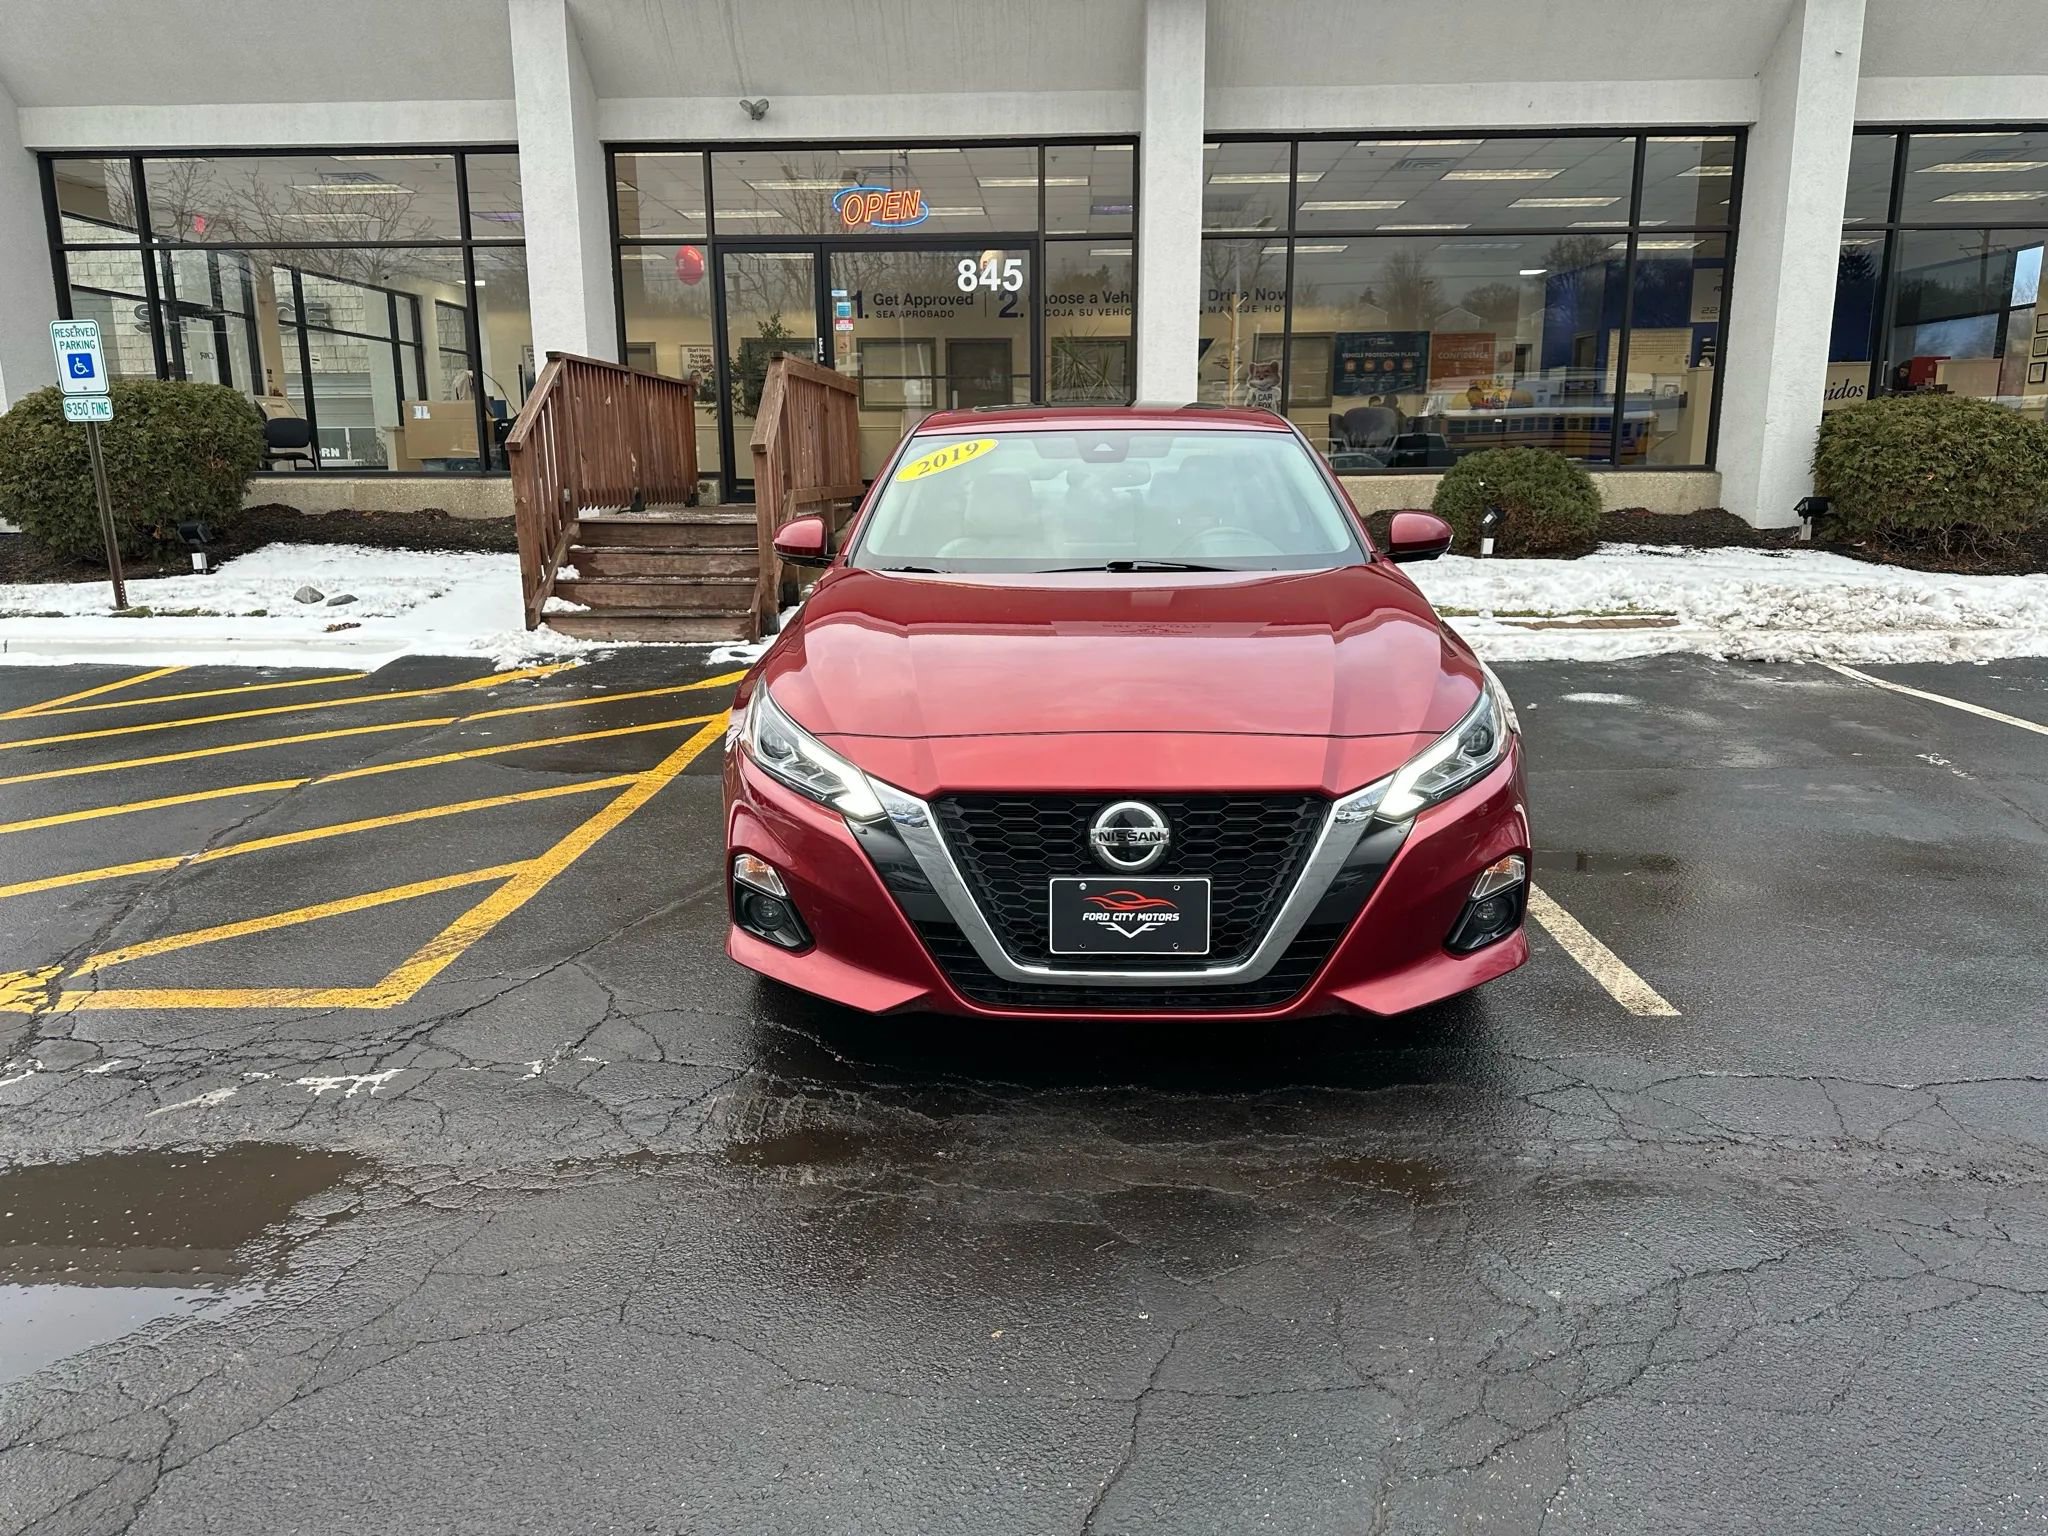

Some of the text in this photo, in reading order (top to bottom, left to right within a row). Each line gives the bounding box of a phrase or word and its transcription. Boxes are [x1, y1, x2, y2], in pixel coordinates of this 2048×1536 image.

[843, 190, 920, 225] OPEN
[957, 259, 1024, 292] 845
[873, 293, 900, 306] Get
[903, 292, 974, 309] Approved
[1089, 294, 1098, 304] a
[1079, 308, 1093, 316] SU
[1264, 304, 1285, 313] HO
[876, 310, 955, 319] SEA APROBADO
[54, 327, 96, 338] RESERVED
[60, 340, 96, 350] PARKING
[1438, 351, 1489, 359] CONFIDENCE
[1258, 393, 1273, 401] CAR
[66, 401, 110, 416] $350 FINE
[917, 442, 980, 476] 2019
[1099, 831, 1162, 842] NISSAN
[1082, 912, 1180, 922] FORD CITY MOTORS
